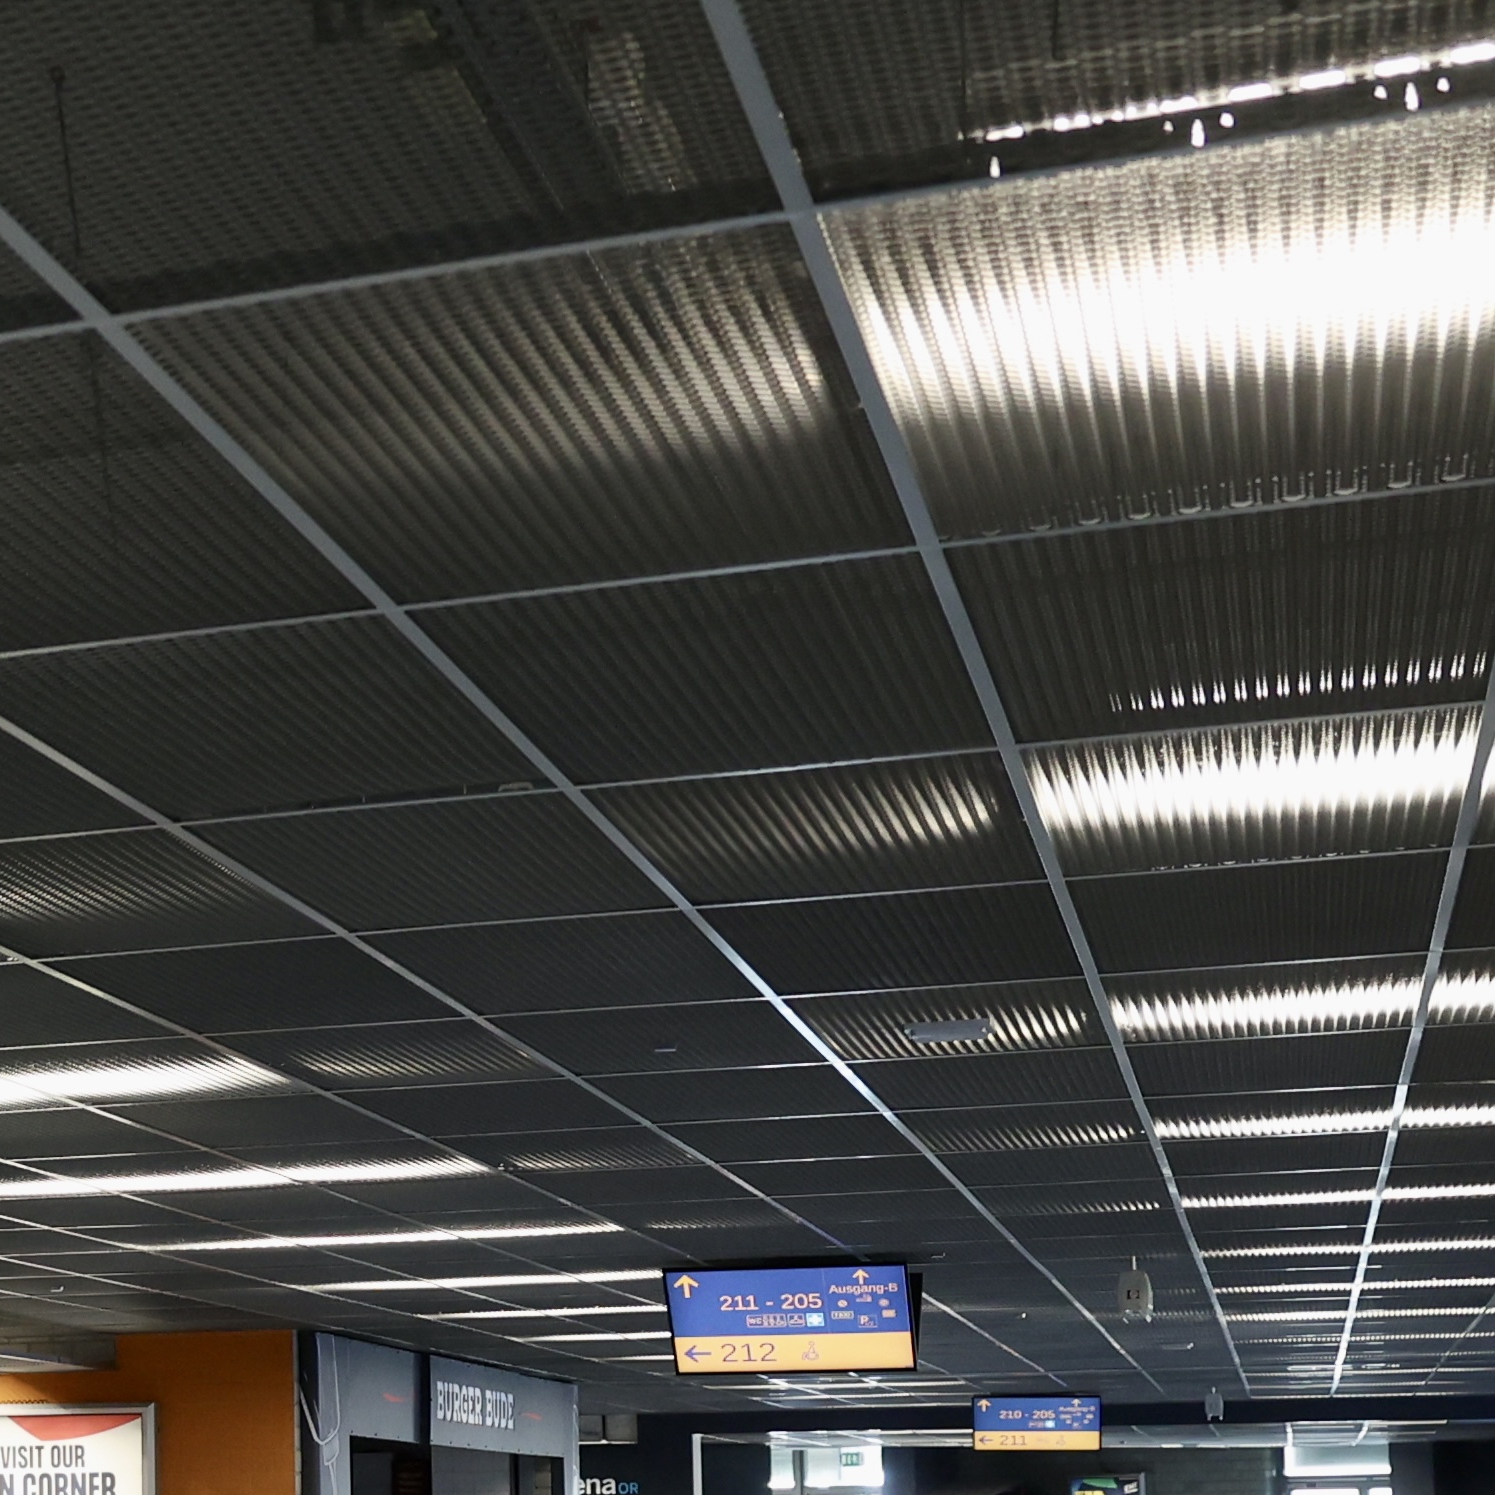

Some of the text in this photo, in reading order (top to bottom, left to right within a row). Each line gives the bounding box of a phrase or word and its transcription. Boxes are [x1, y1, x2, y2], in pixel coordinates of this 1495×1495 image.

[719, 1294, 759, 1311] 211
[780, 1293, 823, 1310] 205
[721, 1342, 777, 1362] 212
[437, 1380, 515, 1430] BURGER BUDE
[999, 1410, 1022, 1419] 210
[1032, 1410, 1056, 1419] 205
[1000, 1435, 1027, 1446] 211
[0, 1445, 85, 1469] VISIT OUR
